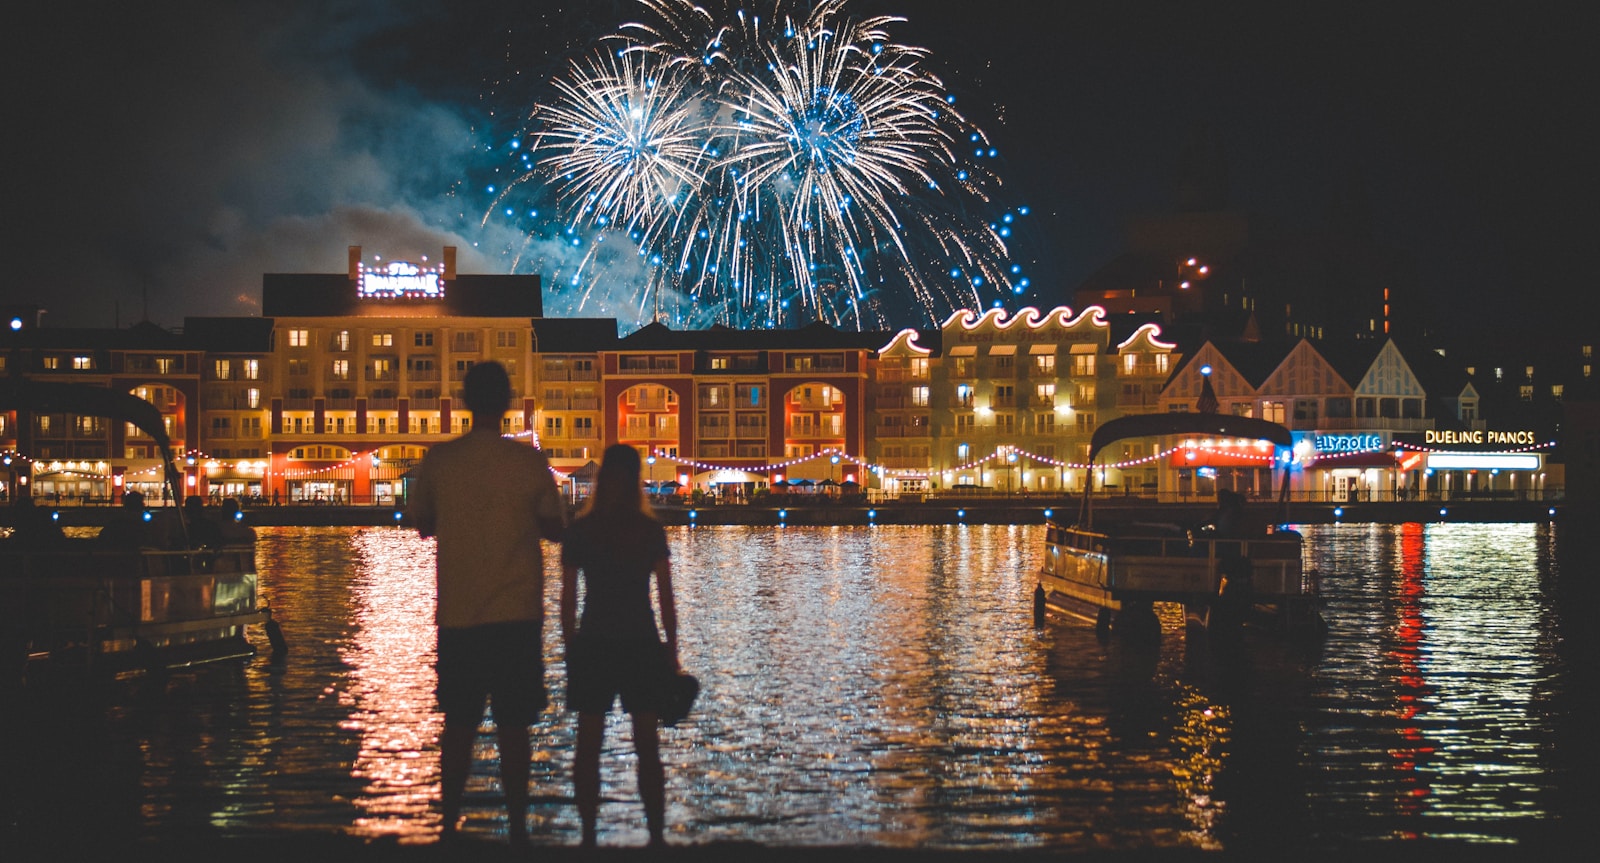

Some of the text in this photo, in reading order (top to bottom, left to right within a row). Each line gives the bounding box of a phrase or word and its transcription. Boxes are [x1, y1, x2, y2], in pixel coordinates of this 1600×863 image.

[959, 330, 993, 343] Crest
[1016, 328, 1045, 343] The
[1049, 328, 1091, 342] Wave
[1314, 435, 1382, 451] ELLYROLLS
[1425, 430, 1535, 445] DUELING PIANOS
